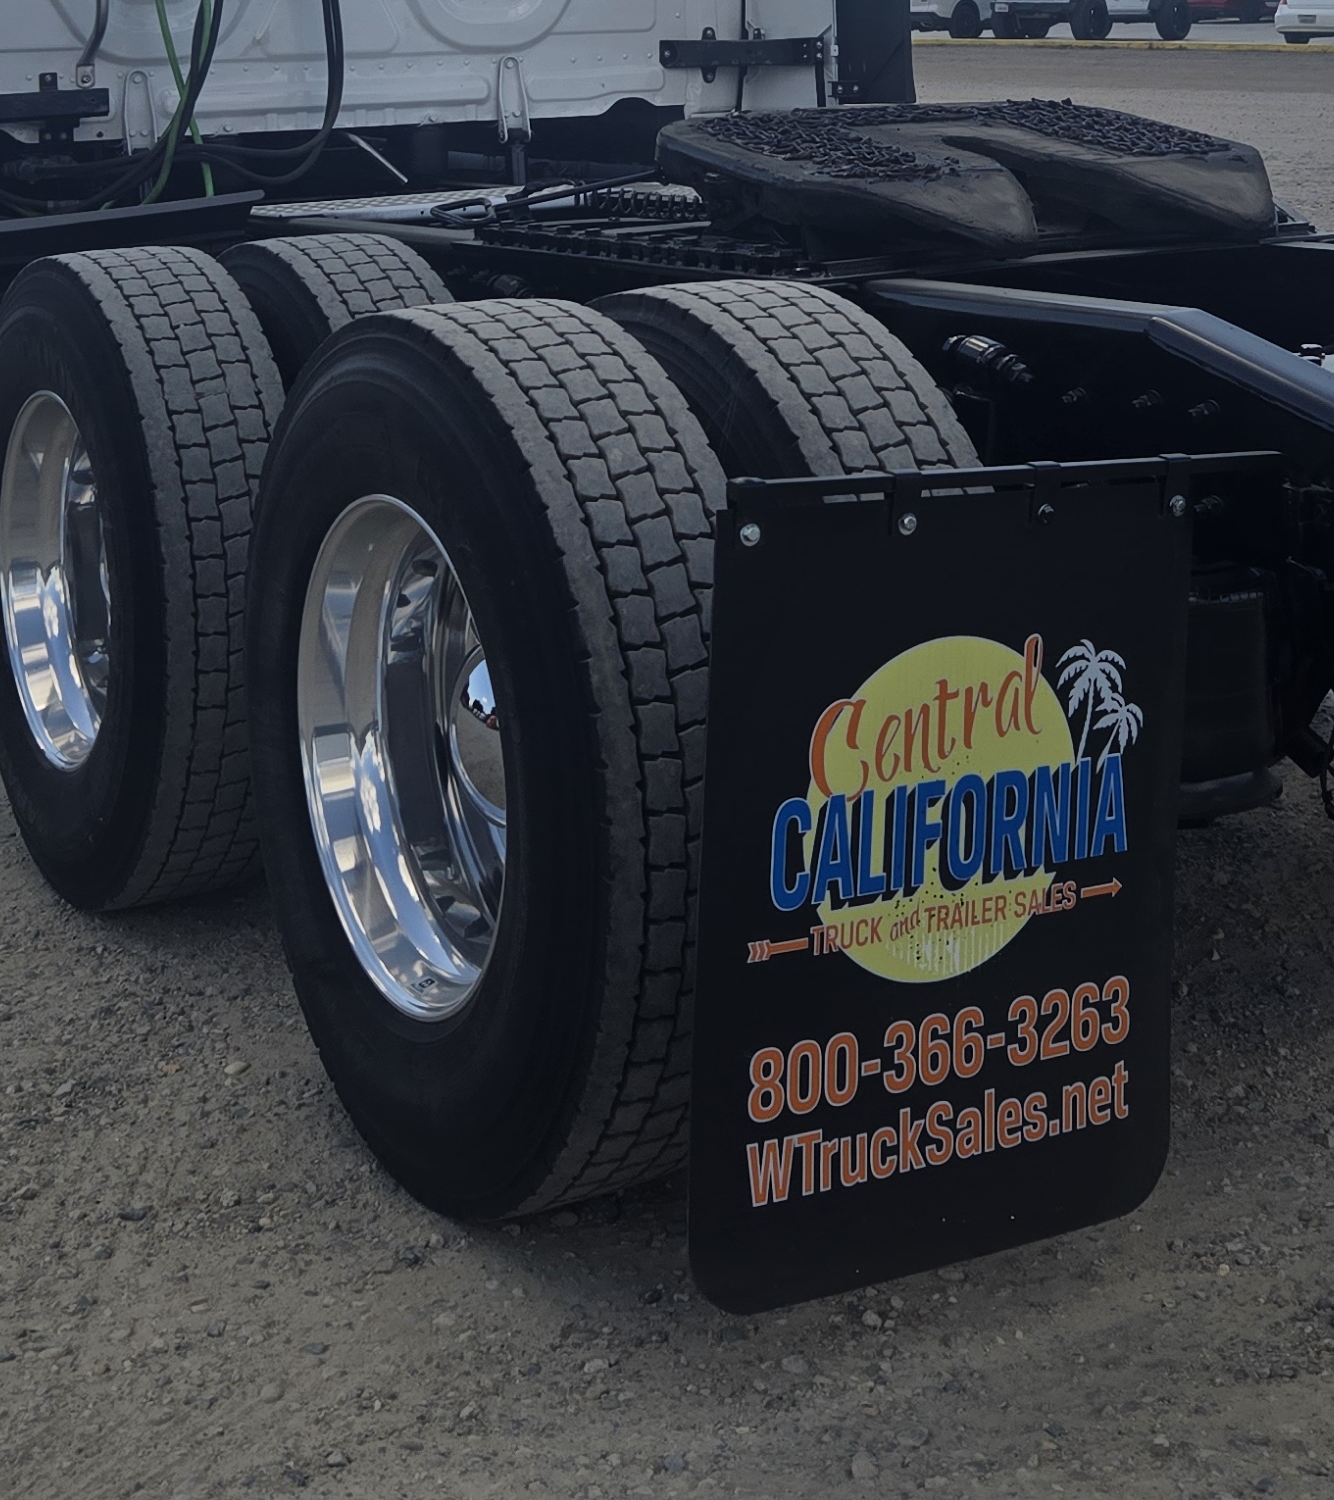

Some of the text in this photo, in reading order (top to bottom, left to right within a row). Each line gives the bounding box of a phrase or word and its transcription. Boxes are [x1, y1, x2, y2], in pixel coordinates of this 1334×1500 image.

[809, 632, 1043, 802] Central
[769, 751, 1129, 913] CALIFORNIA
[809, 883, 1077, 956] TRUCK and TRAILER SALES
[747, 974, 1131, 1124] 800-366-3263
[746, 1060, 1130, 1208] WTruckSales.net
